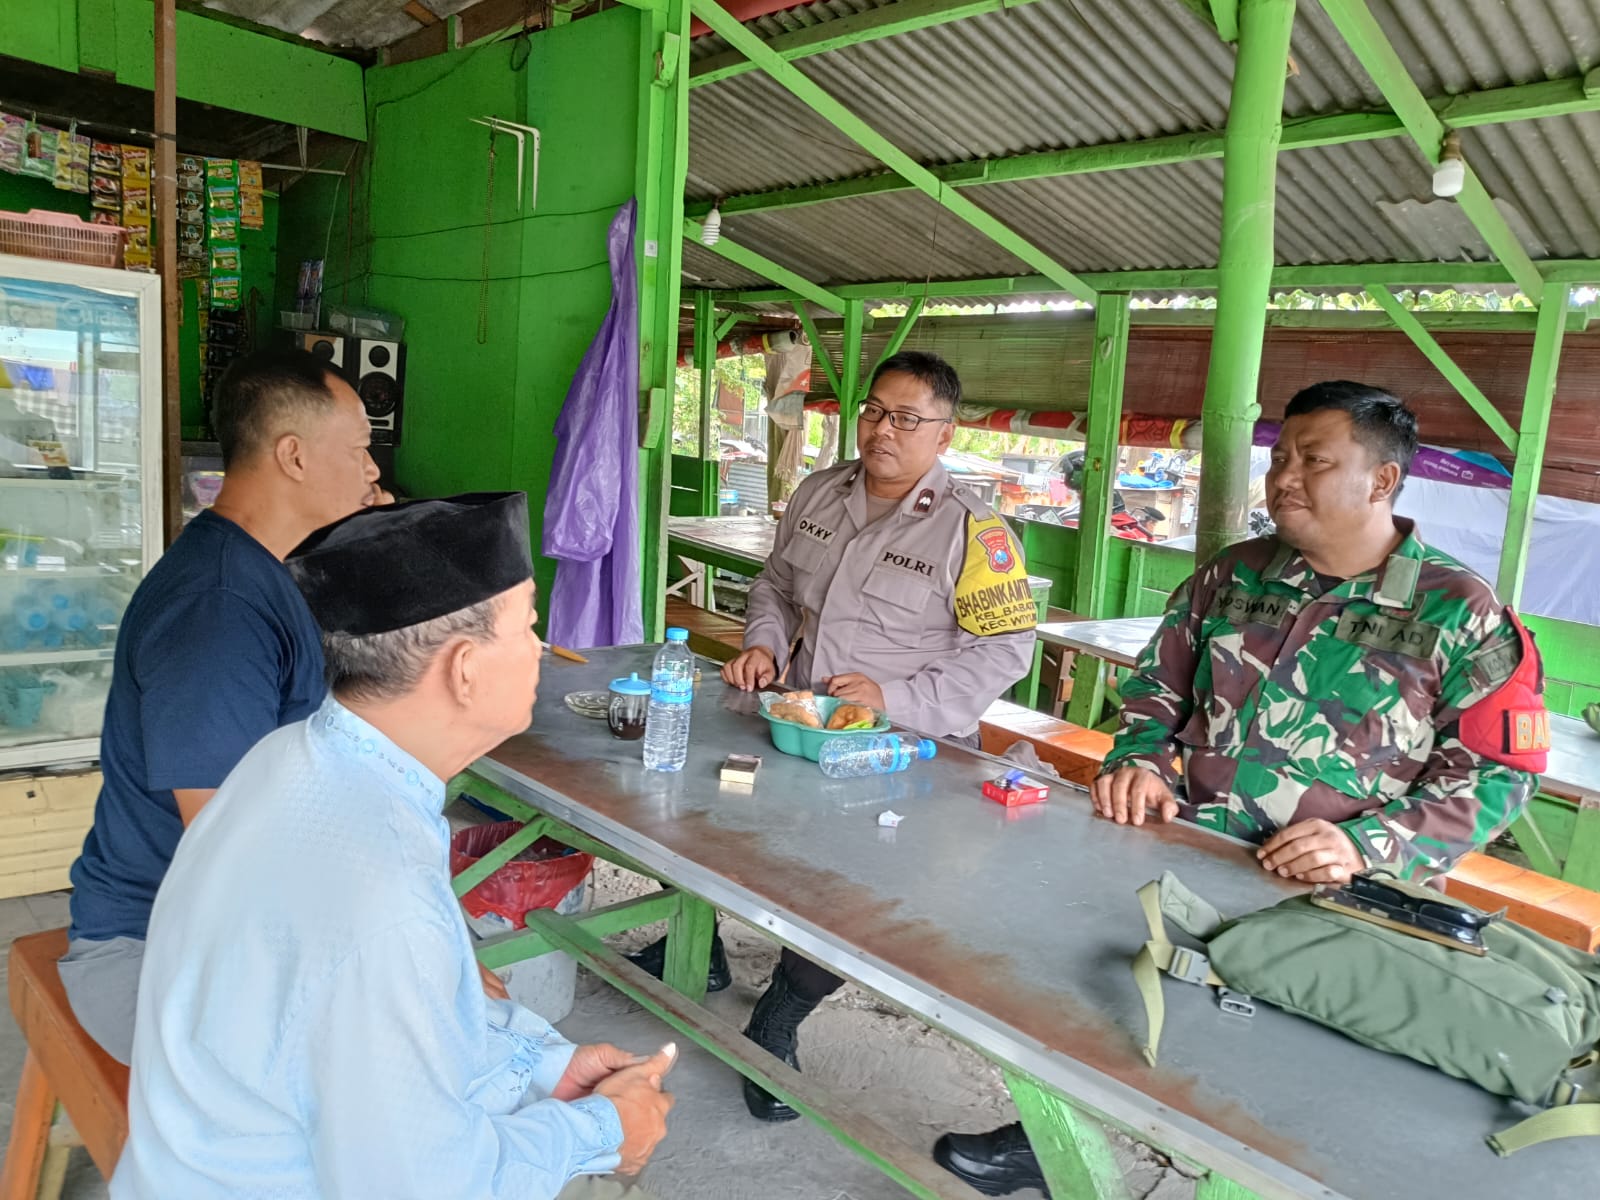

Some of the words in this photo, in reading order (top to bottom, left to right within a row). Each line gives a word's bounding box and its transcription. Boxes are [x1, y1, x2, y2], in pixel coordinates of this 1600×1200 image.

[799, 519, 832, 541] OKKY
[881, 551, 935, 577] POLRI
[1350, 621, 1384, 638] TNI
[1390, 630, 1424, 646] AD
